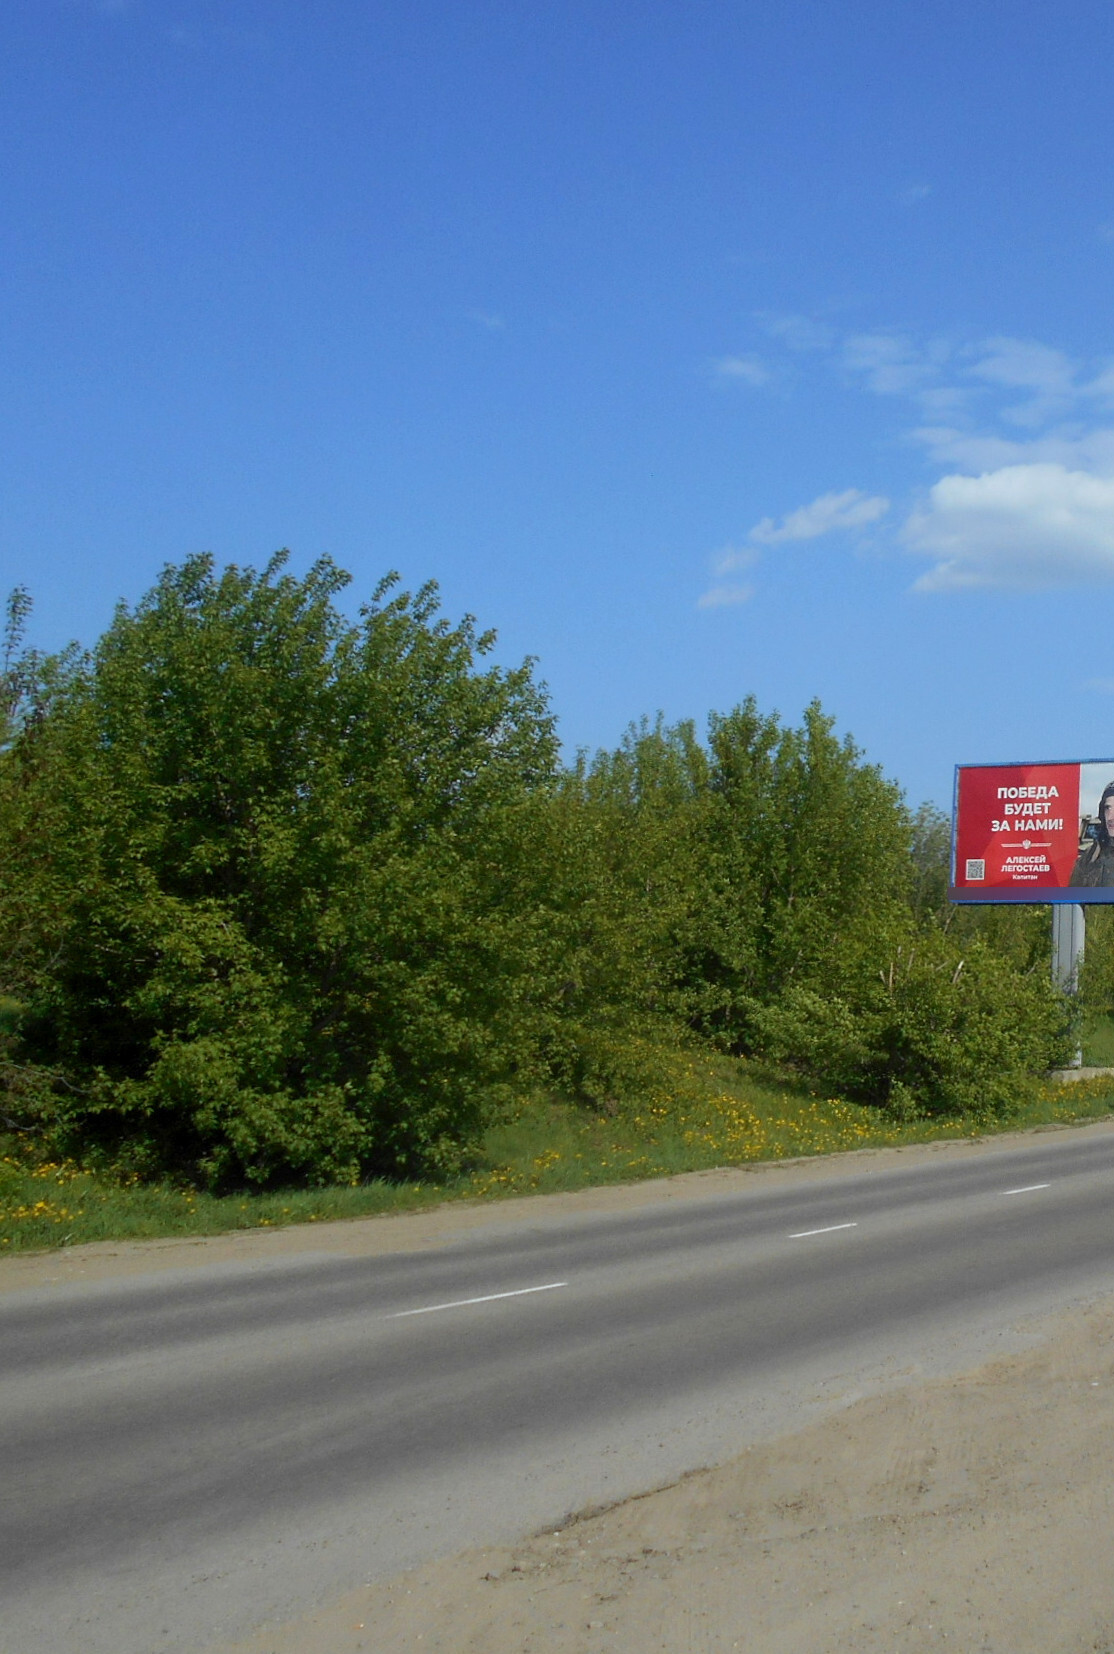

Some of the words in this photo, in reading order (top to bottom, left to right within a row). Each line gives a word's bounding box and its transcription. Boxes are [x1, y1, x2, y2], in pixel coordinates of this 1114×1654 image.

[997, 786, 1060, 800] ПОБЕДА
[1004, 802, 1052, 816] БУДЕТ
[991, 820, 1011, 832] ЗА
[1014, 818, 1064, 831] НАМИ!
[1006, 855, 1047, 864] АЛЕКСЕЙ
[1000, 864, 1051, 872] ЛЕГОСТАЕВ
